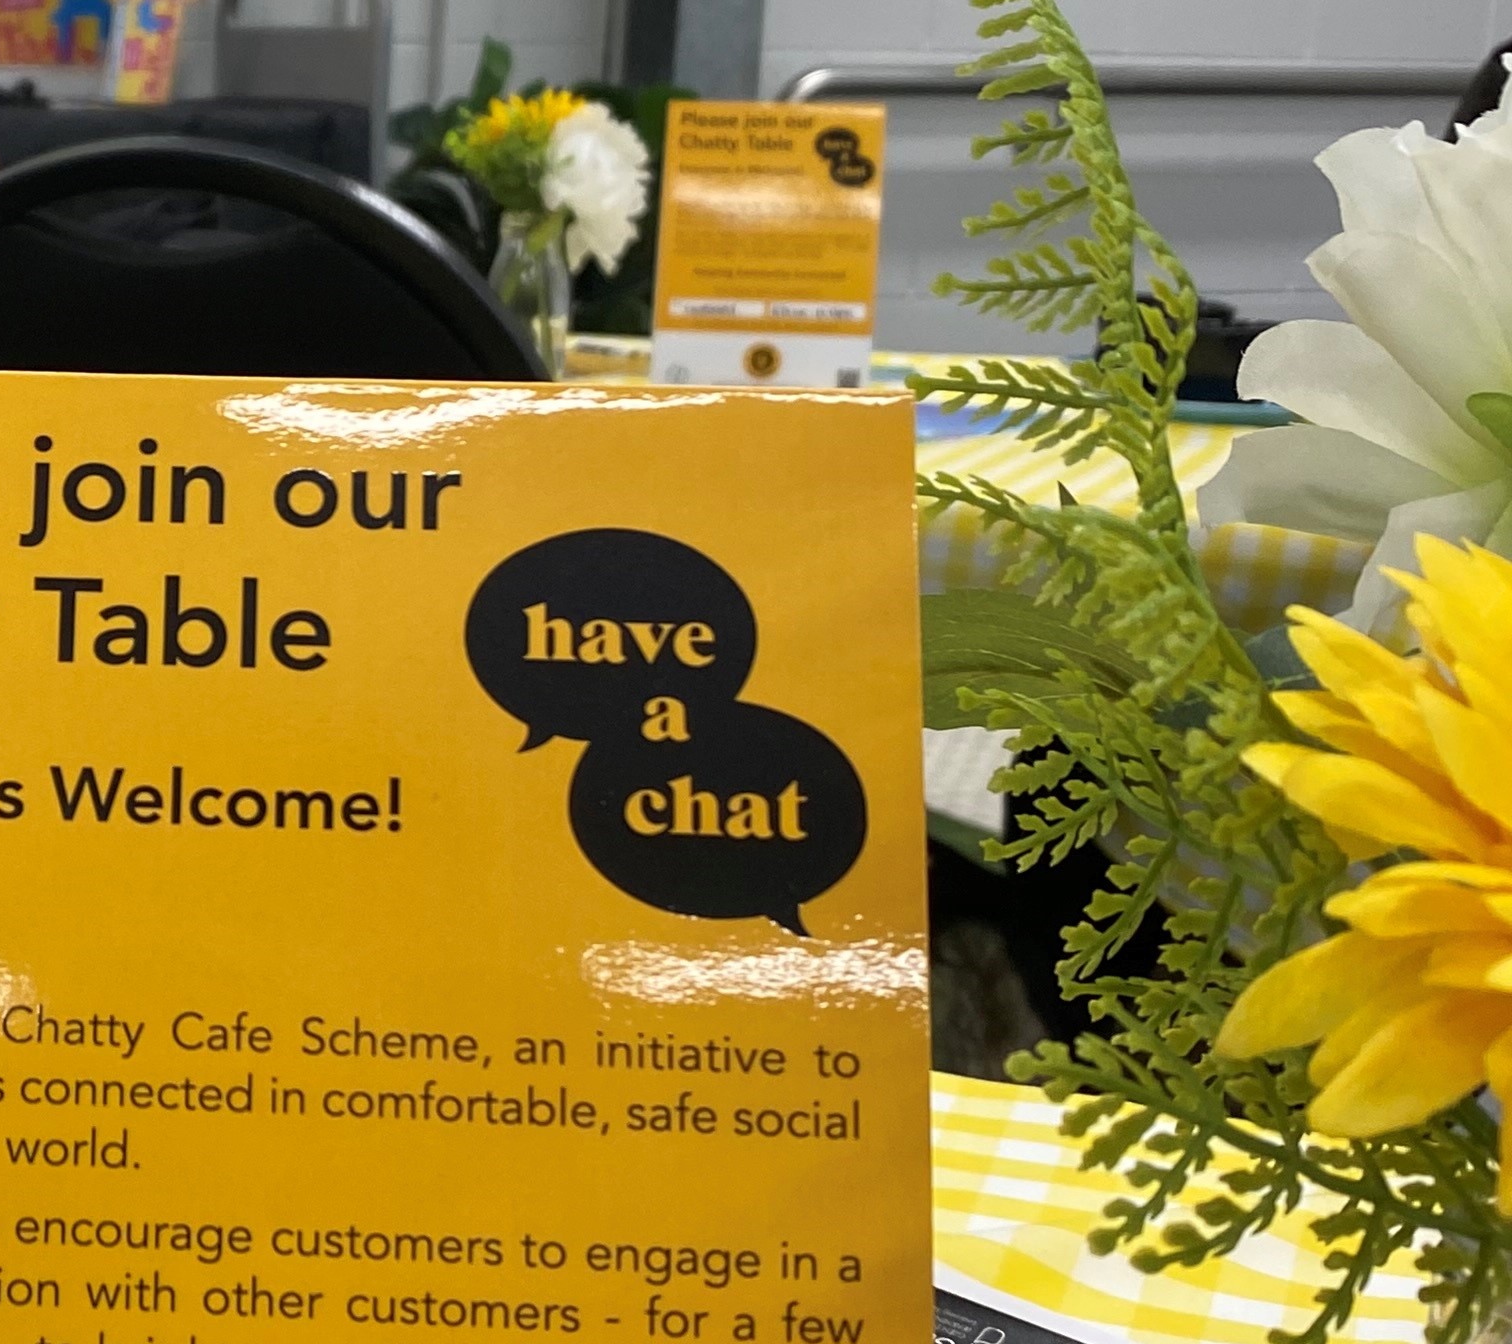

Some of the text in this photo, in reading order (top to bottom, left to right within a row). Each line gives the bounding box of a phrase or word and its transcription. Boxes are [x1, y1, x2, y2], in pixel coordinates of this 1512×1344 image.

[16, 433, 229, 549] join
[271, 464, 465, 536] our
[31, 572, 335, 675] Table
[521, 601, 719, 668] have
[640, 694, 691, 744] a
[49, 763, 408, 835] Welcome!
[622, 773, 811, 840] chat
[0, 1004, 145, 1060] Chatty
[170, 1010, 274, 1054] Cafe
[300, 1015, 493, 1070] Scheme,
[512, 1035, 567, 1066] an
[593, 1030, 788, 1076] initiative
[816, 1043, 861, 1081] to
[19, 1072, 254, 1115] connected
[269, 1077, 306, 1116] in
[322, 1081, 611, 1136] comfortable,
[625, 1092, 719, 1136] safe
[732, 1099, 861, 1142] social
[5, 1127, 142, 1170] world.
[14, 1213, 254, 1263] encourage
[271, 1224, 504, 1267] customers
[520, 1234, 569, 1270] to
[586, 1243, 763, 1288] engage
[779, 1241, 819, 1283] in
[837, 1254, 863, 1284] a
[86, 1270, 177, 1312] with
[202, 1276, 324, 1320] other
[346, 1291, 582, 1334] customers
[645, 1295, 708, 1340] for
[731, 1311, 756, 1341] a
